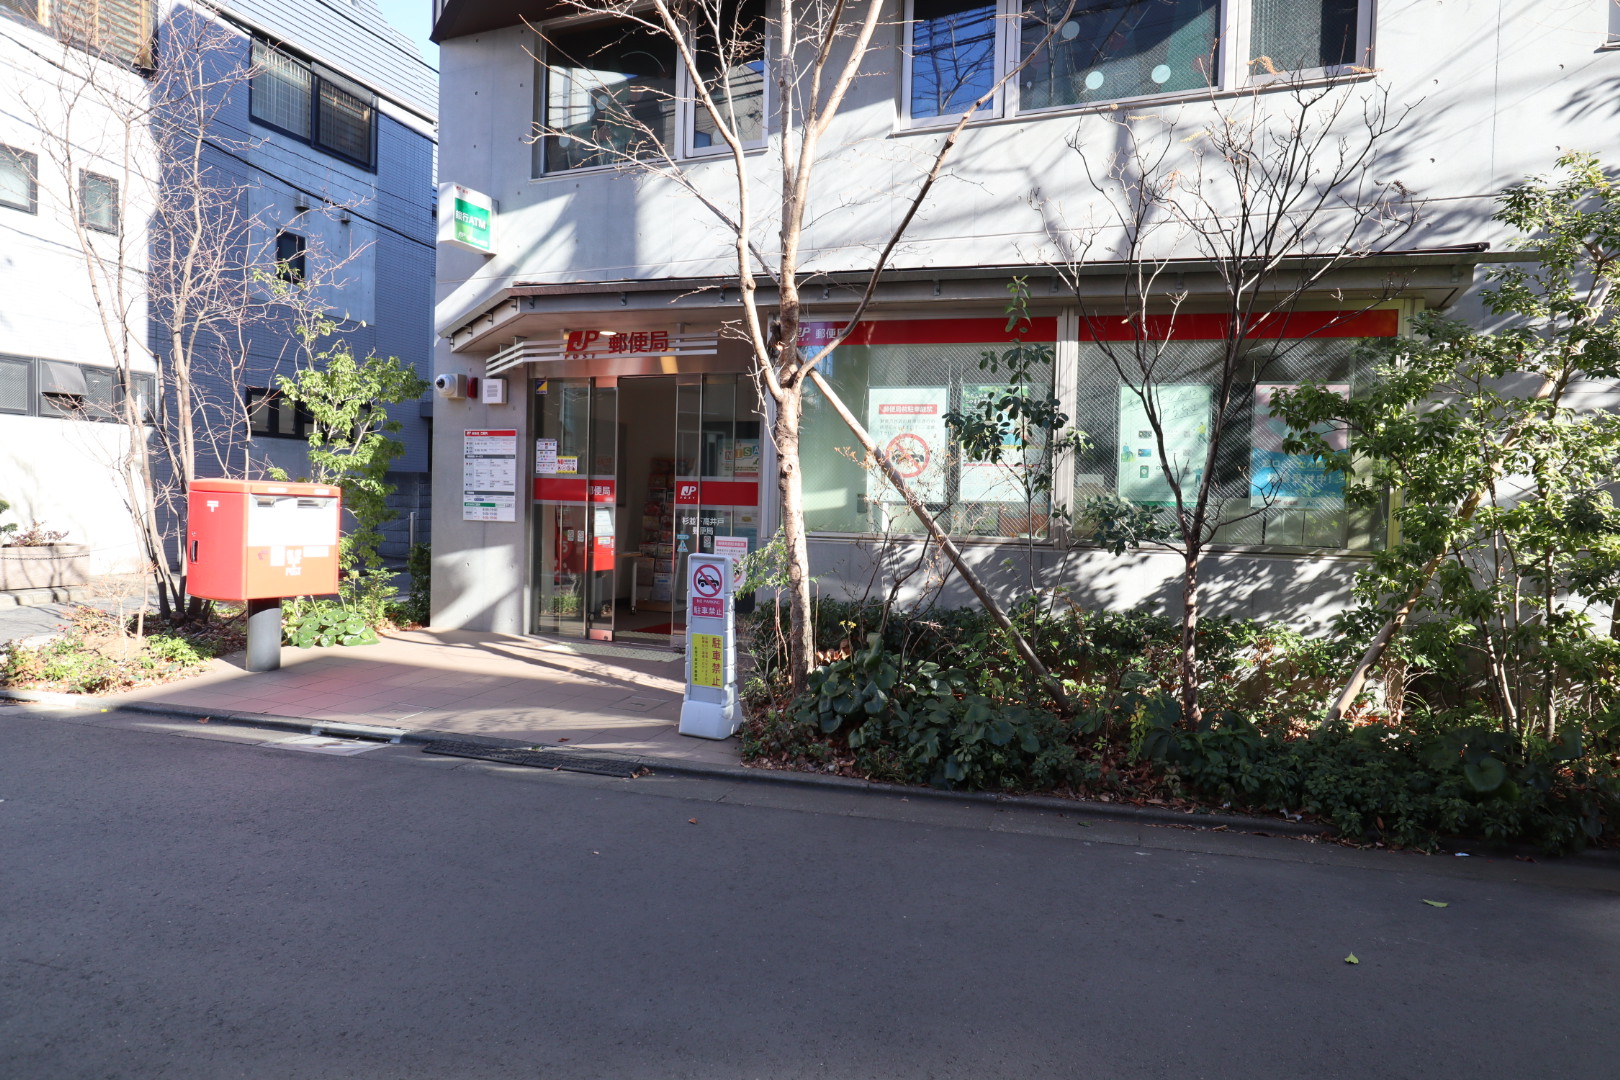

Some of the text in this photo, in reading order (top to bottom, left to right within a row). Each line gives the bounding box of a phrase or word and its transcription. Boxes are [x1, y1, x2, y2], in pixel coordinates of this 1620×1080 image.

[566, 330, 669, 354] JP 郵便局
[725, 446, 759, 460] NISA
[681, 486, 697, 496] JP
[694, 606, 722, 616] 駐車禁止
[712, 637, 721, 687] 駐車禁止
